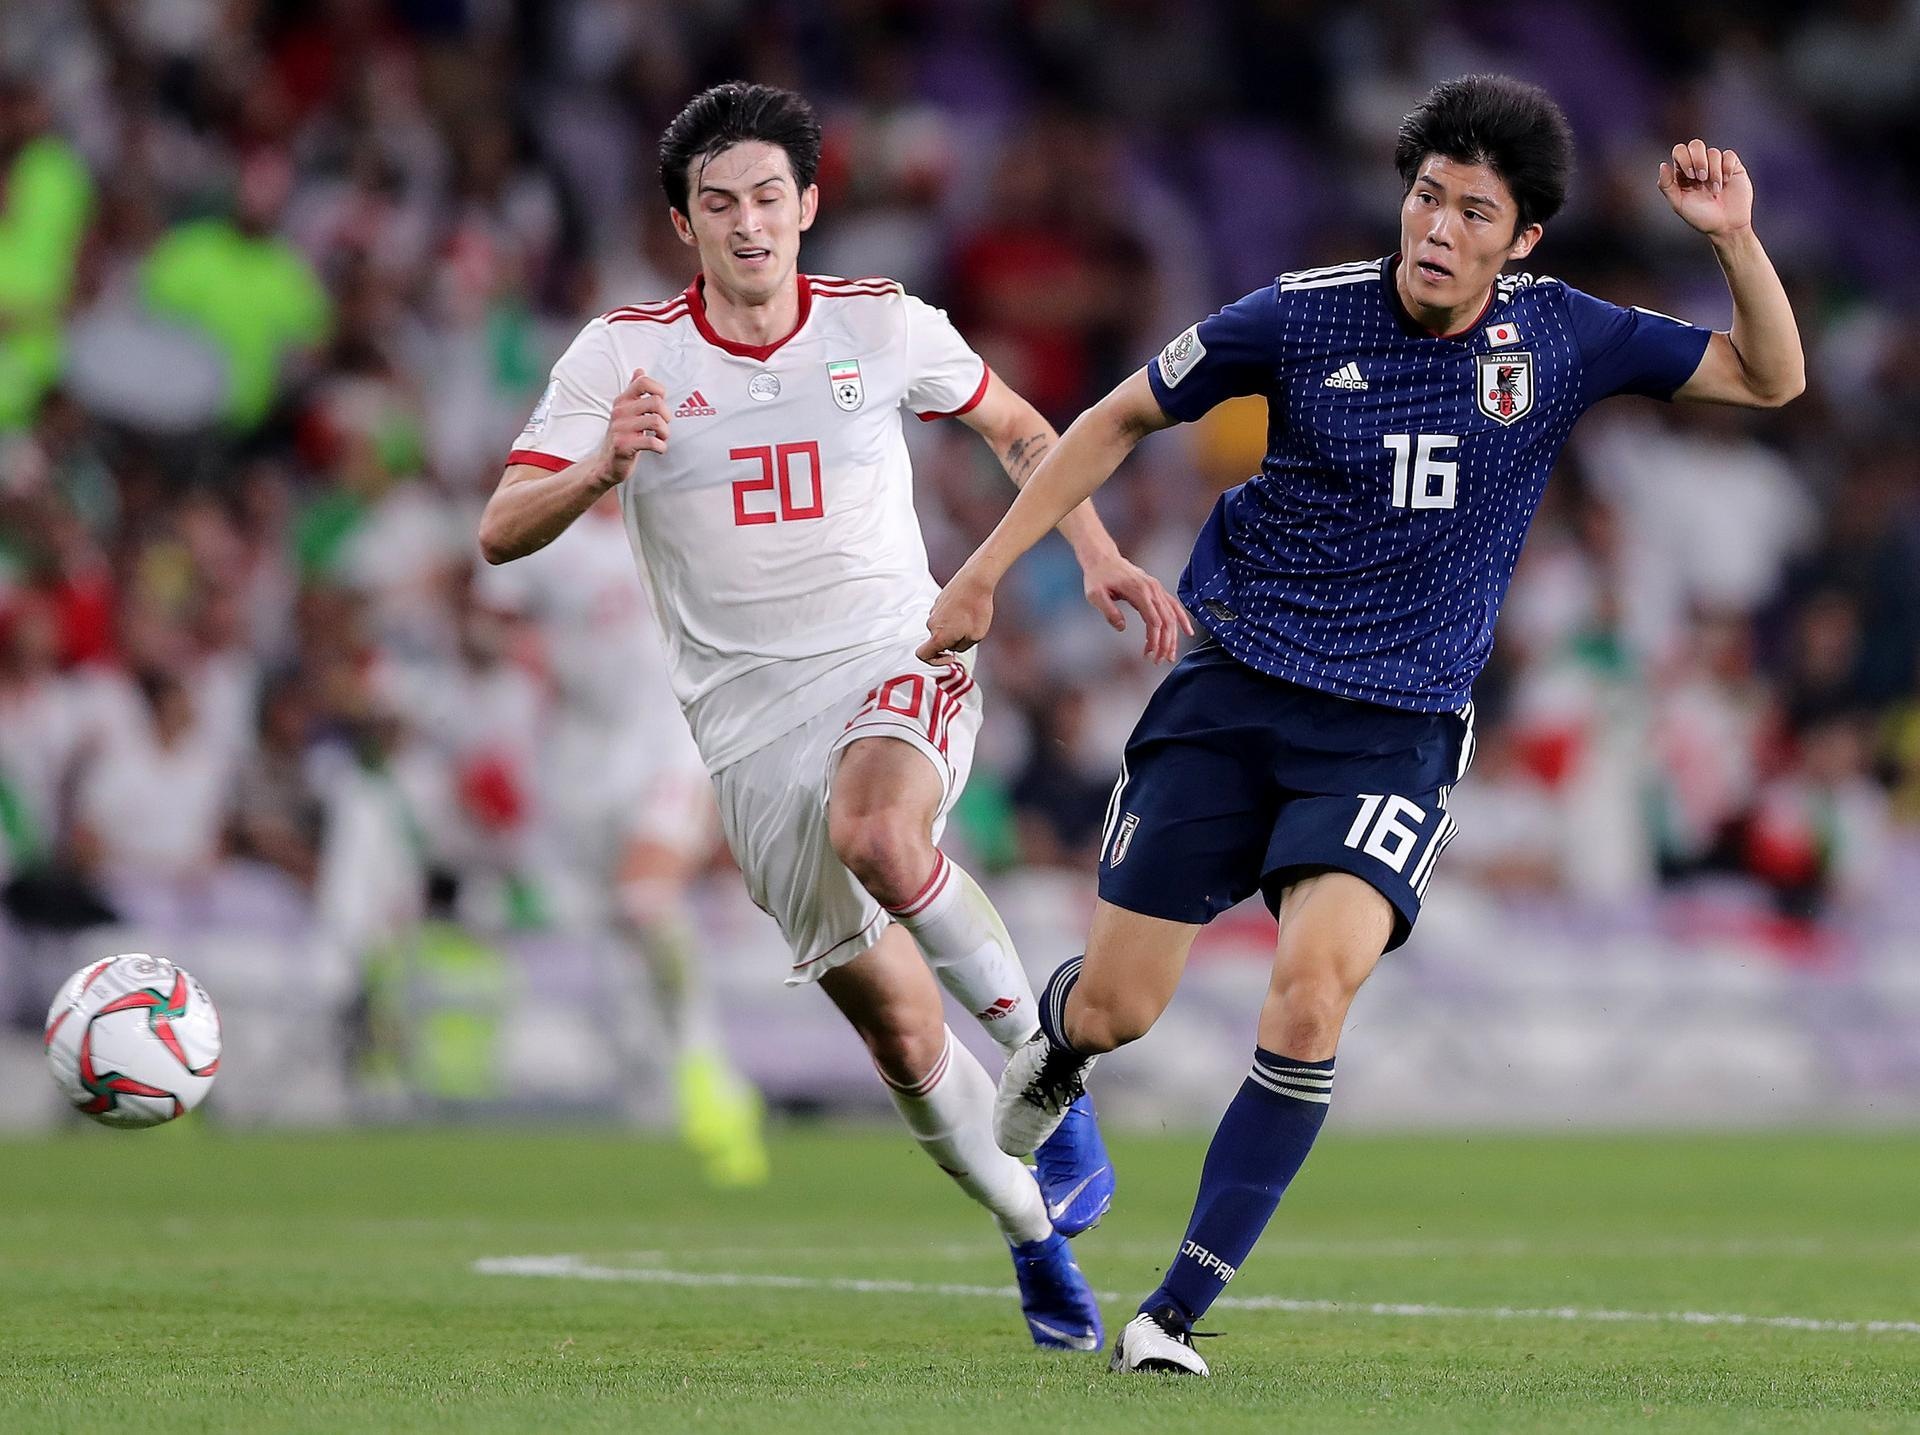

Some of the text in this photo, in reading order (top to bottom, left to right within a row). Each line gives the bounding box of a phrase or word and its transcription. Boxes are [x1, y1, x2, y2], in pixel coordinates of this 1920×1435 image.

[1491, 355, 1519, 363] JAPAN
[1324, 377, 1369, 390] adidas
[674, 406, 717, 418] adidas
[1494, 400, 1518, 412] JFA
[729, 440, 824, 526] 20
[1382, 433, 1459, 510] 16
[1343, 793, 1427, 874] 16
[1181, 1239, 1236, 1284] JAPAN
